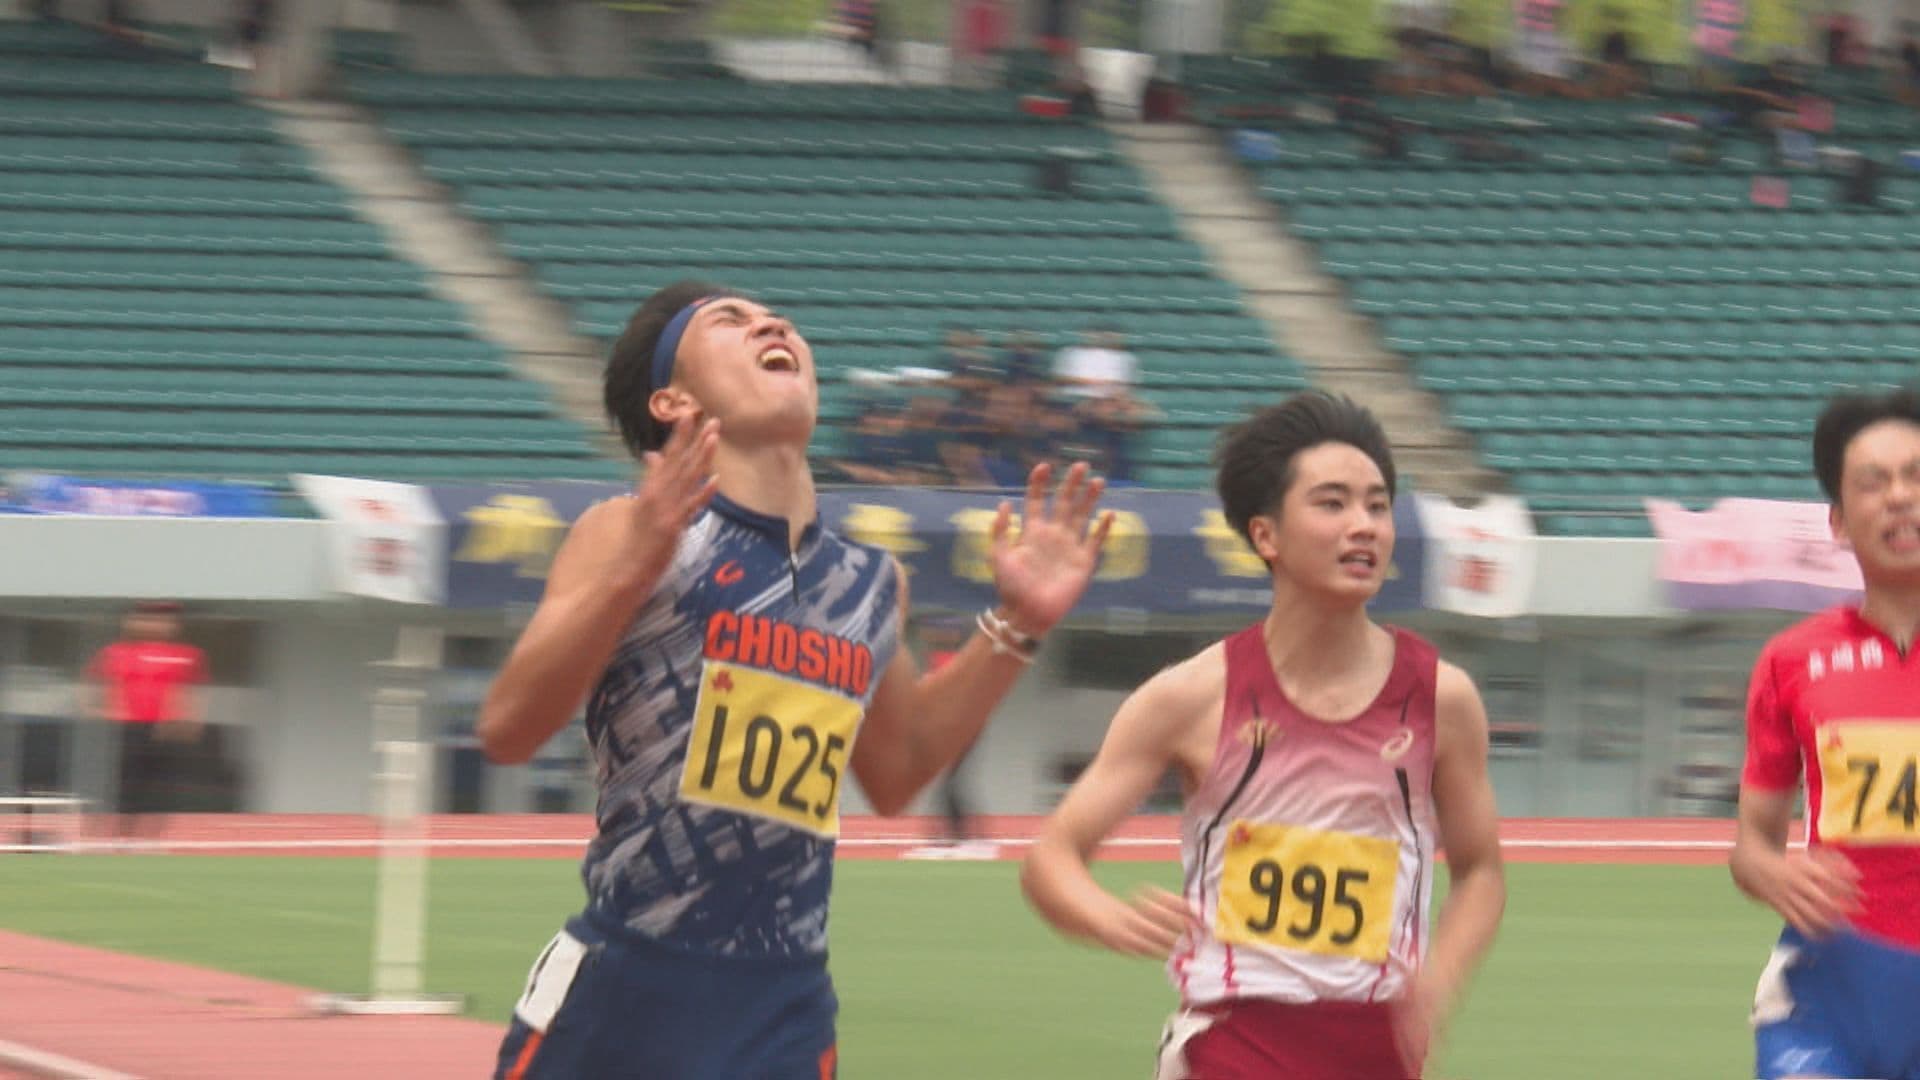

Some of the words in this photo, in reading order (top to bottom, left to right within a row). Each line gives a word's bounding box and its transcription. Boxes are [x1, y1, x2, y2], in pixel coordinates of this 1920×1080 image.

[703, 610, 873, 695] CHOSHO
[700, 705, 845, 818] 1025
[1246, 859, 1369, 944] 995
